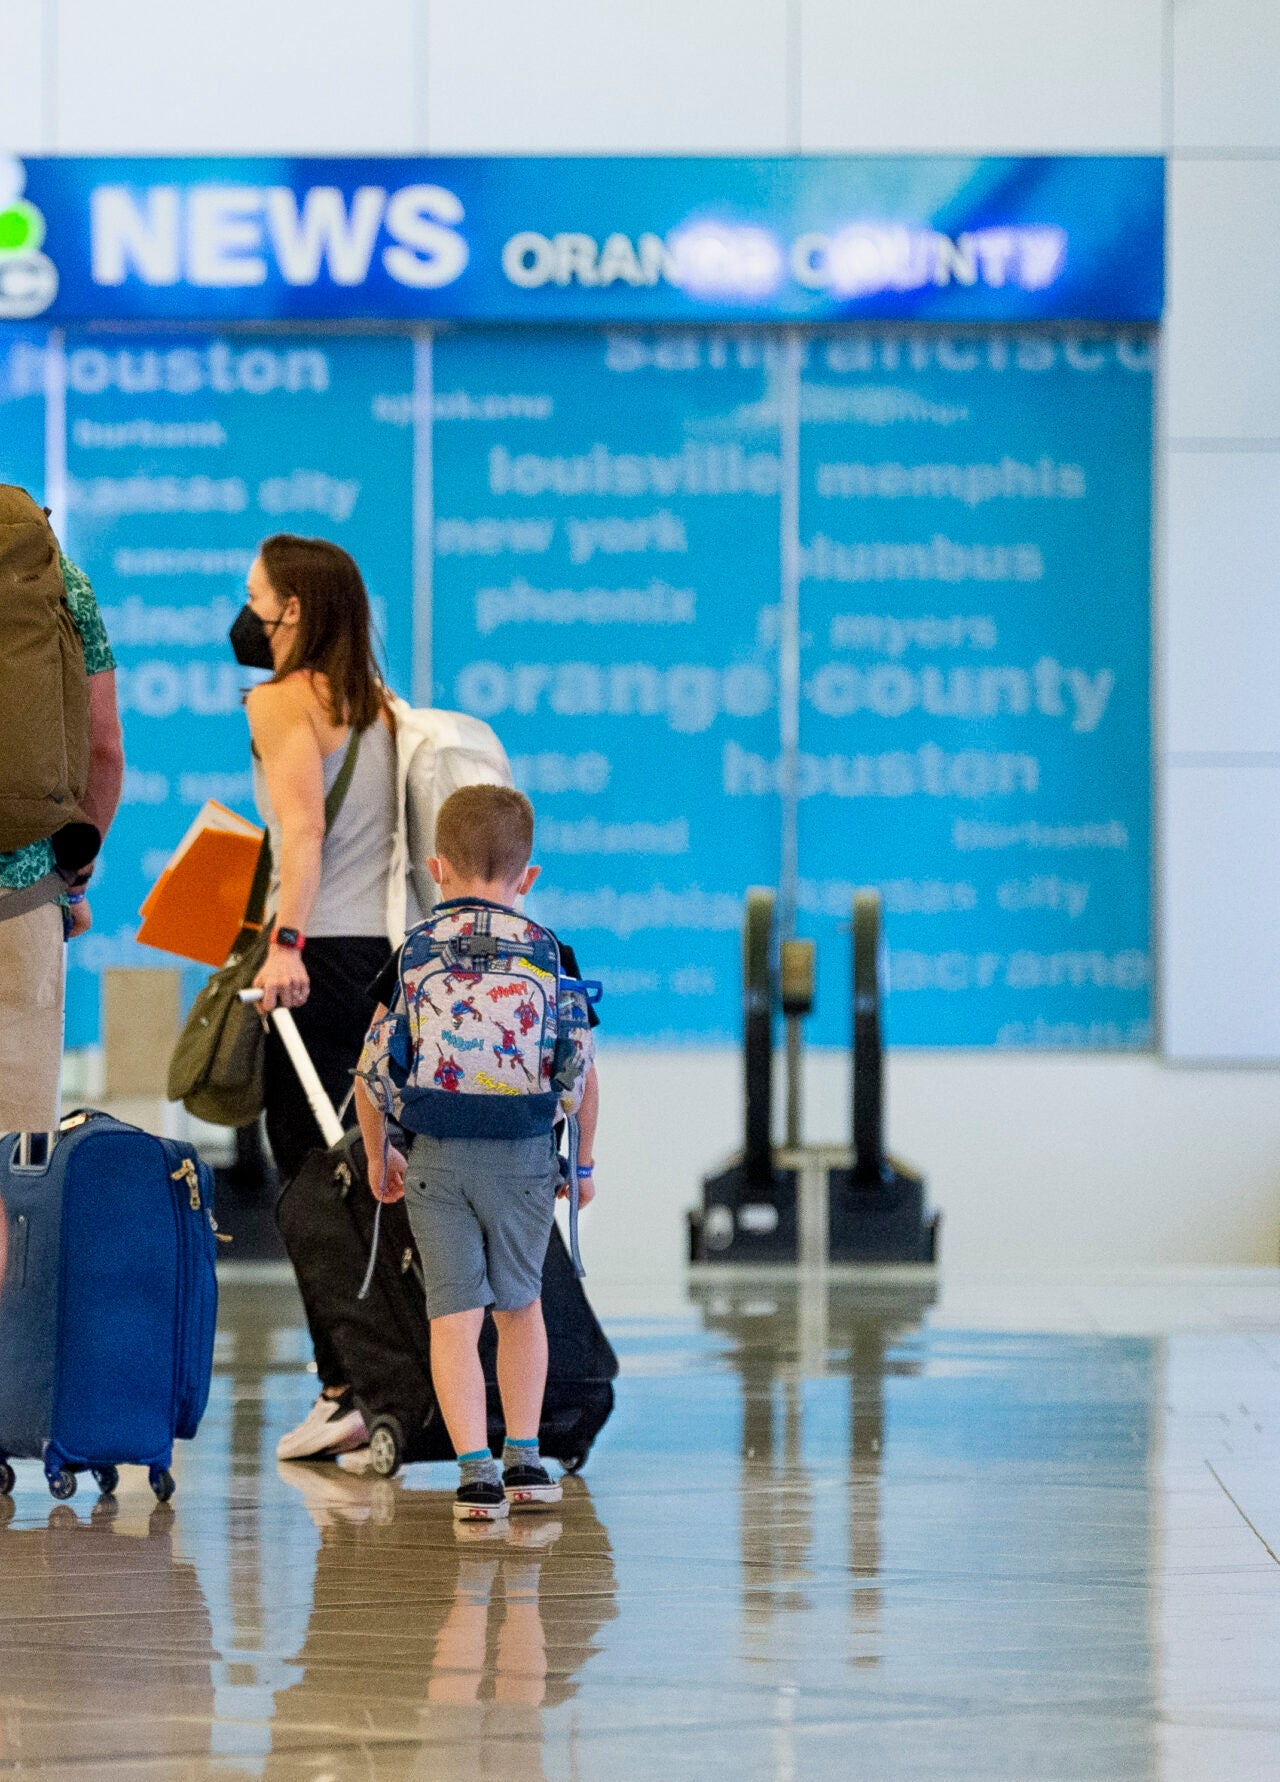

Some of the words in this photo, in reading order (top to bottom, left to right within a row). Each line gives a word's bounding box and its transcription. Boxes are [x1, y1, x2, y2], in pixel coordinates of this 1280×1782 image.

[90, 183, 469, 288] NEWS
[503, 230, 784, 288] ORAN
[792, 228, 1066, 288] CUNTY
[798, 532, 1046, 582] lumbus
[455, 660, 774, 733] orange
[804, 655, 1116, 733] county
